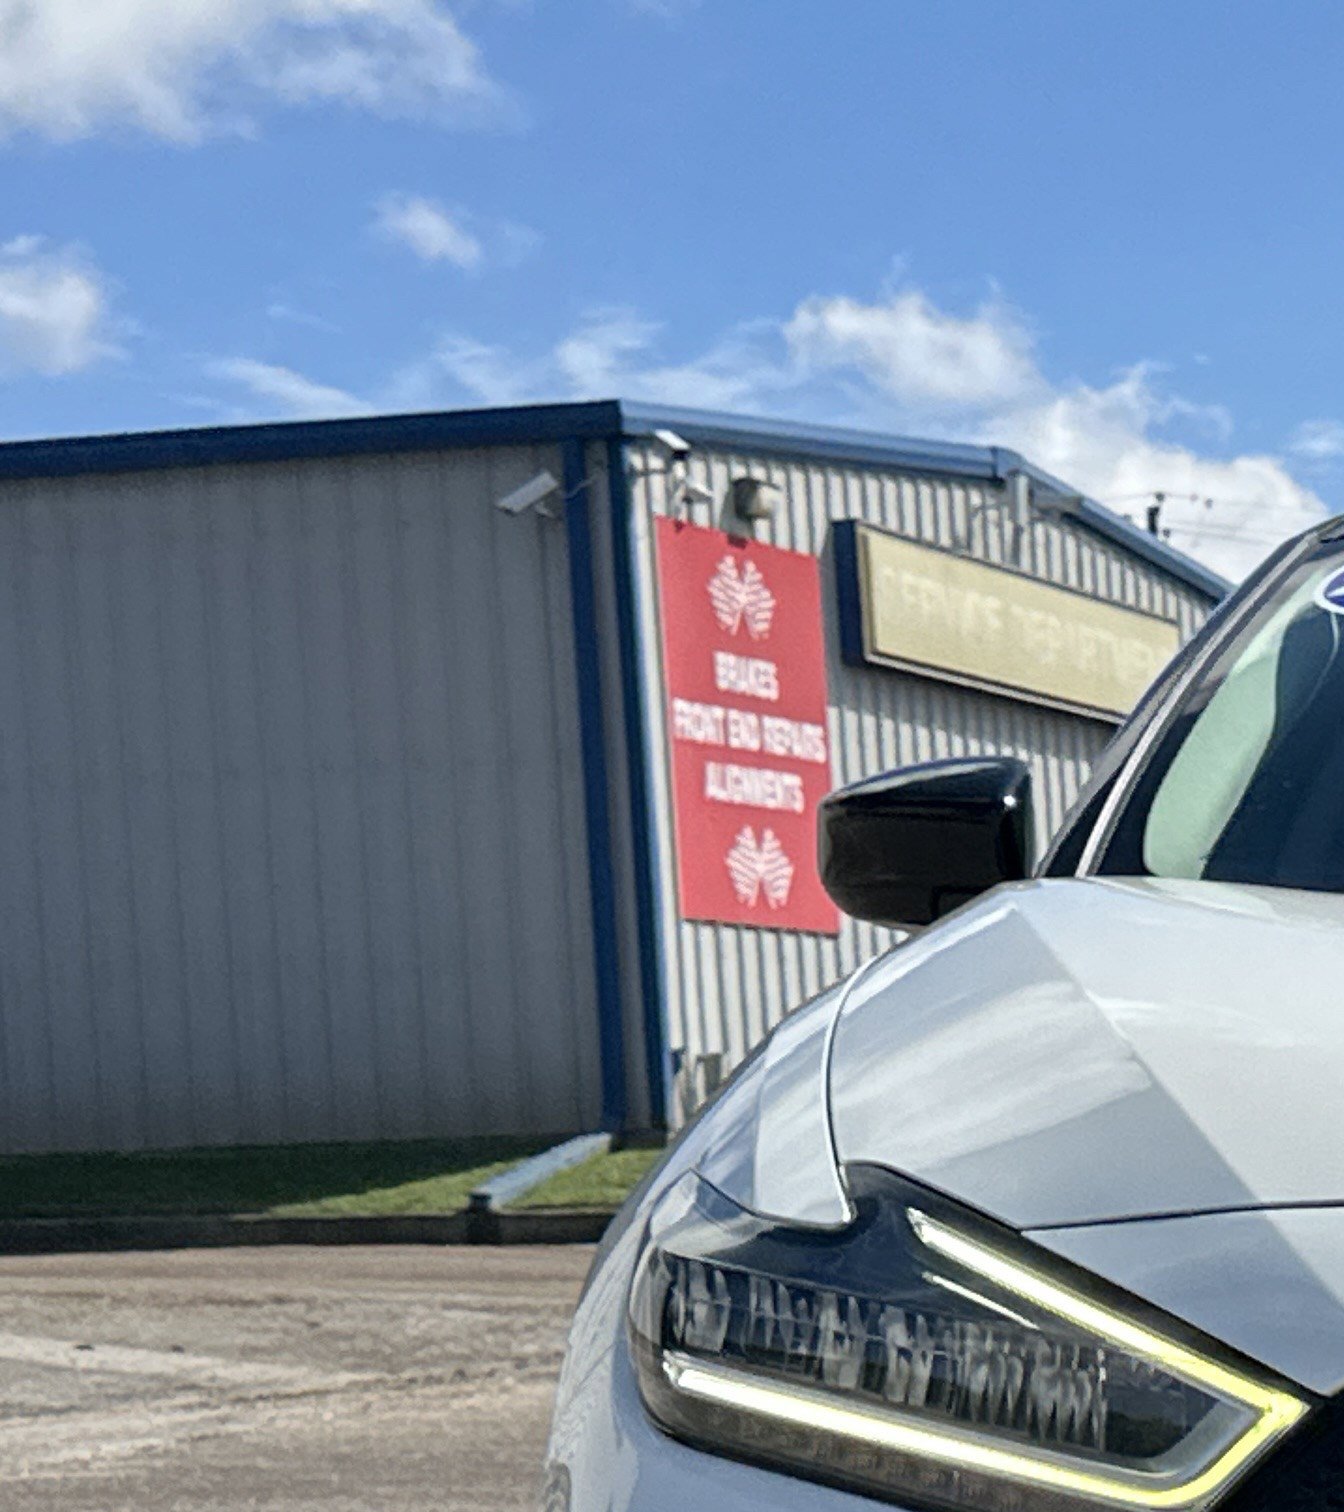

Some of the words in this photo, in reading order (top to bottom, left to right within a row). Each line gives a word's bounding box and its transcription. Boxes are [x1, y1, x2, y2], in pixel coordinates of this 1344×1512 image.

[673, 697, 725, 746] FRONT
[727, 708, 761, 752] END
[761, 714, 827, 764] REPAIRS
[705, 761, 805, 814] ALIGNMENTS
